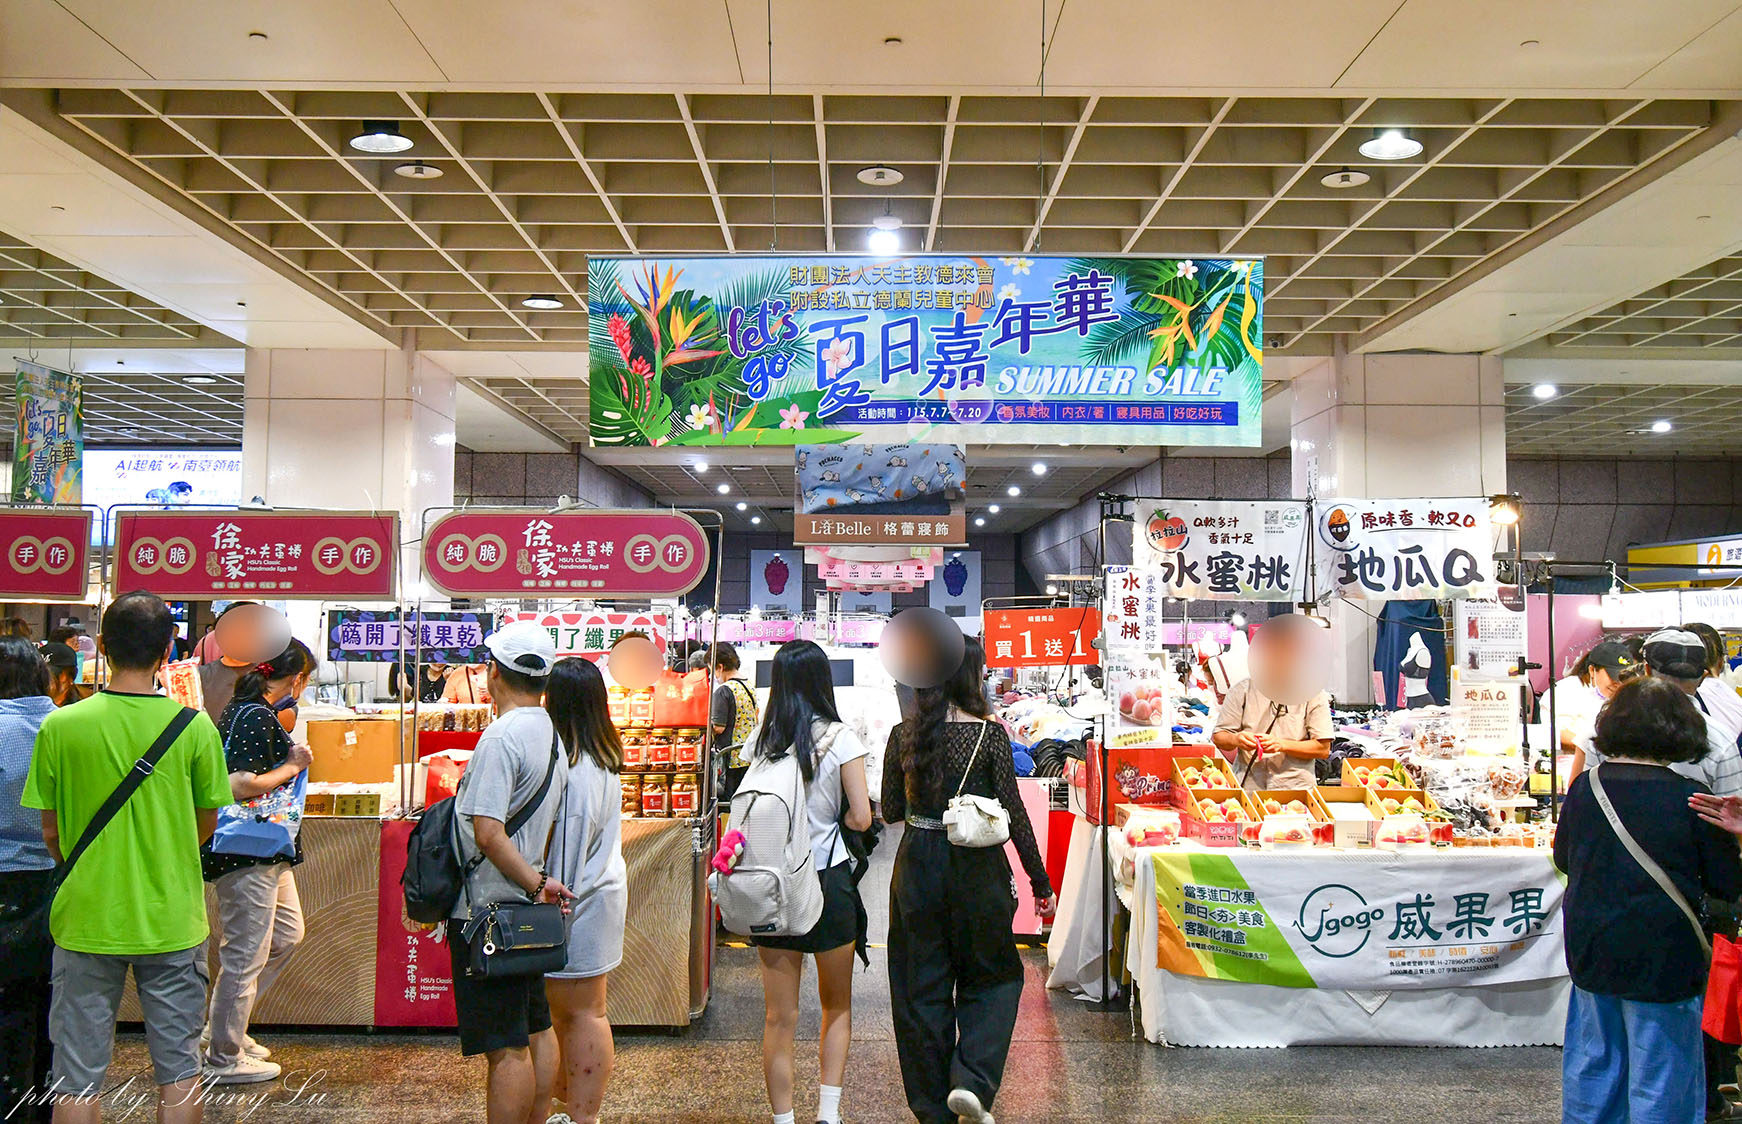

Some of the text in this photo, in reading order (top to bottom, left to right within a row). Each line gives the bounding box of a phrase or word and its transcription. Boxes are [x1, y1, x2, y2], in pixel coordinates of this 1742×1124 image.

[790, 265, 996, 285] 財團法人天主教德來會
[790, 290, 996, 310] 附設私立德蘭兒童中心
[727, 299, 800, 357] let's
[808, 270, 1120, 418] 夏日嘉年華
[742, 353, 793, 400] go
[995, 365, 1228, 397] SUMMER SALE
[1002, 406, 1050, 419] 香氛美妝
[1173, 407, 1222, 419] 好吃好玩
[1193, 516, 1239, 528] Q軟多汁
[1150, 524, 1189, 542] 拉拉山
[1208, 532, 1254, 545] 香氣十足
[18, 545, 66, 565] 手作
[137, 545, 187, 565] 純脆
[211, 522, 247, 580] 徐家
[321, 546, 372, 566] 手作
[446, 544, 496, 562] 純脆
[522, 519, 558, 578] 徐家
[634, 545, 685, 563] 手作
[1160, 550, 1291, 595] 水蜜桃
[1337, 544, 1485, 593] 地瓜Q
[1121, 572, 1140, 640] 水蜜桃
[1126, 668, 1160, 680] 水蜜桃
[1464, 689, 1507, 701] 地瓜Q
[1184, 885, 1256, 905] 當季進口水果
[1388, 887, 1550, 942] 威果果
[1184, 921, 1246, 944] 客製化禮盒
